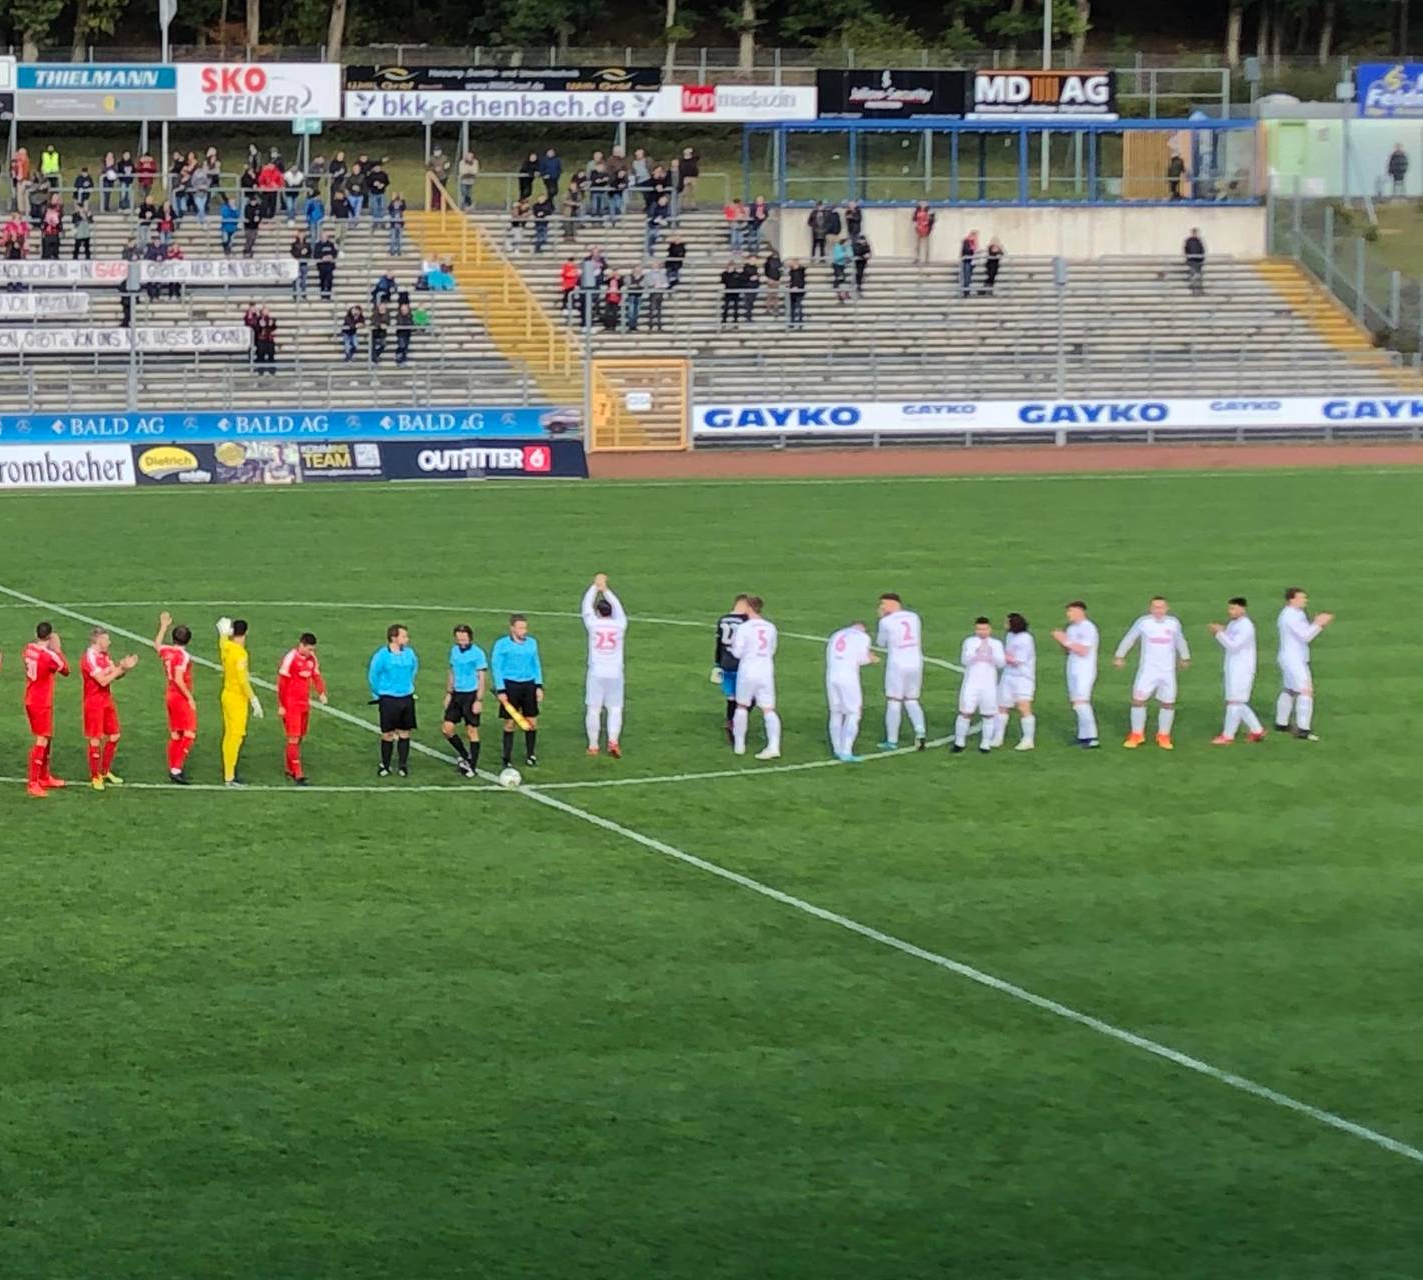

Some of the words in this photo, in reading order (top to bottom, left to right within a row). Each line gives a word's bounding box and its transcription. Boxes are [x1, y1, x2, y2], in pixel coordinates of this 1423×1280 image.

[34, 70, 159, 88] THIELMANN
[201, 67, 267, 94] SKO
[976, 76, 1031, 103] MD
[1060, 76, 1110, 104] AG
[203, 94, 300, 115] STEINER
[382, 94, 626, 117] bkk-achenbach.de
[704, 406, 862, 428] GAYKO
[902, 404, 977, 415] GAYKO
[1018, 402, 1170, 423] GAYKO
[70, 417, 129, 436] BALD
[134, 417, 165, 435] AG
[236, 416, 294, 434] BALD
[300, 415, 329, 433] AG
[397, 414, 456, 432] BALD
[145, 454, 192, 466] Dietrich
[303, 453, 352, 468] TEAM
[417, 449, 524, 471] OUTFITTER
[596, 631, 617, 650] 25
[757, 630, 768, 651] 5
[901, 621, 914, 641] 2
[835, 634, 846, 653] 6
